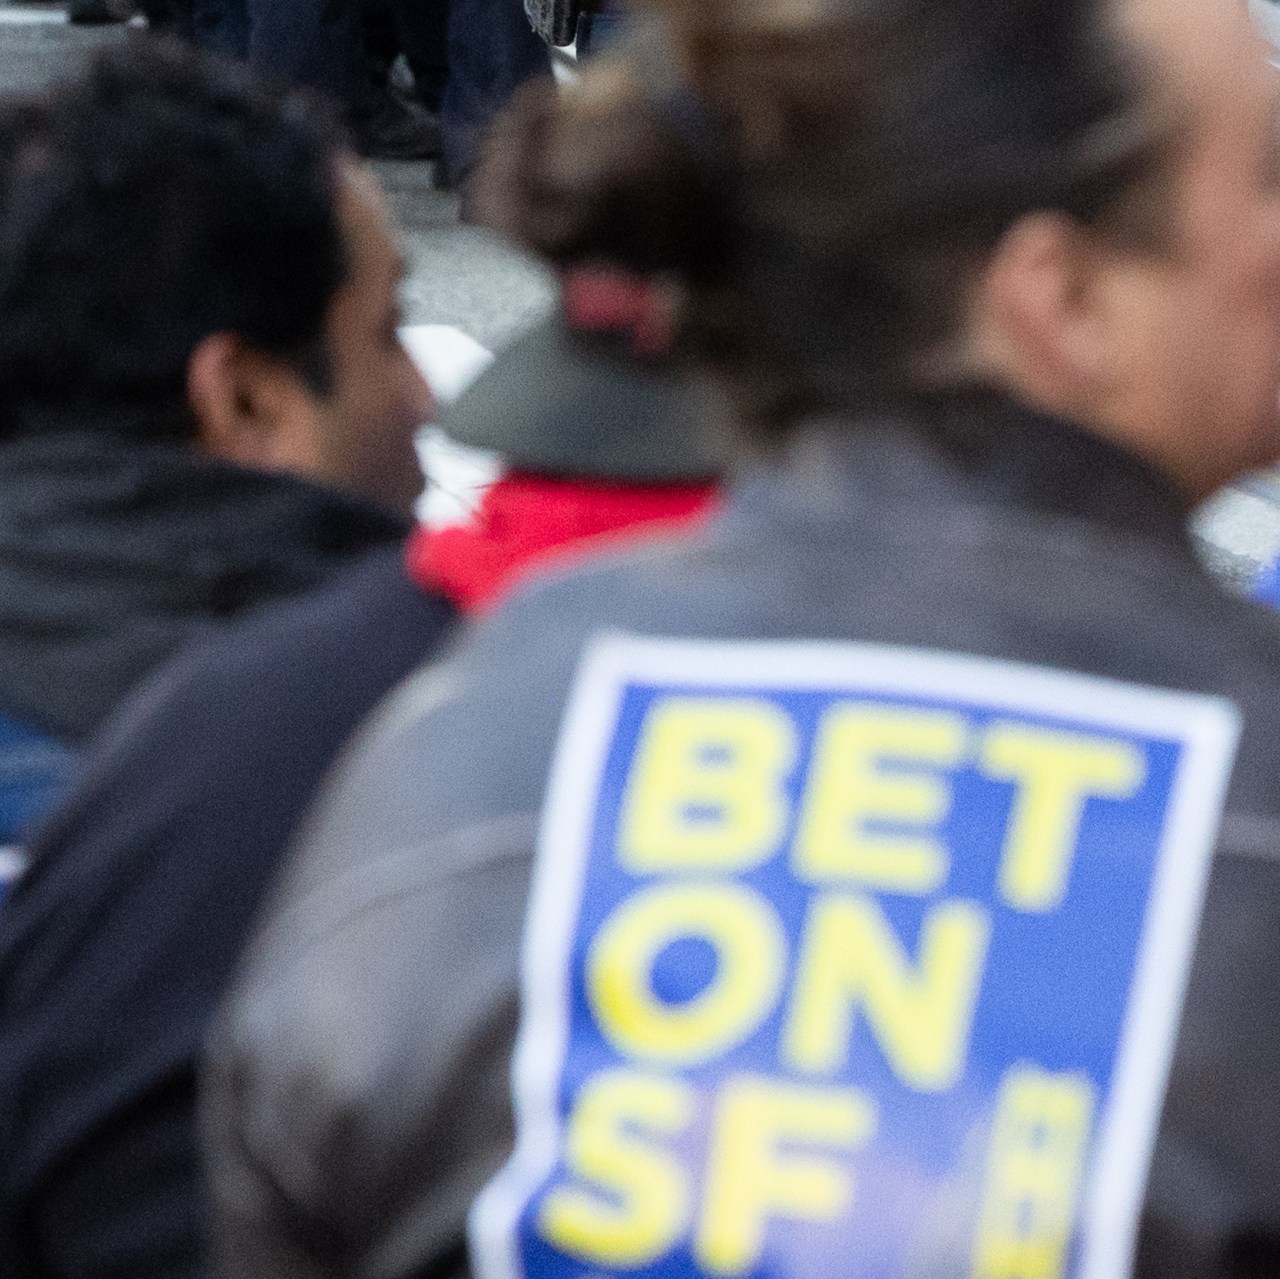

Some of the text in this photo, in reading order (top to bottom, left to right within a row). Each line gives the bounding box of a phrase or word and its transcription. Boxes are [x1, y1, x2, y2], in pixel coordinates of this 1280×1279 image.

[615, 691, 1147, 913] BET
[584, 877, 993, 1094] ON
[536, 1062, 877, 1278] SF
